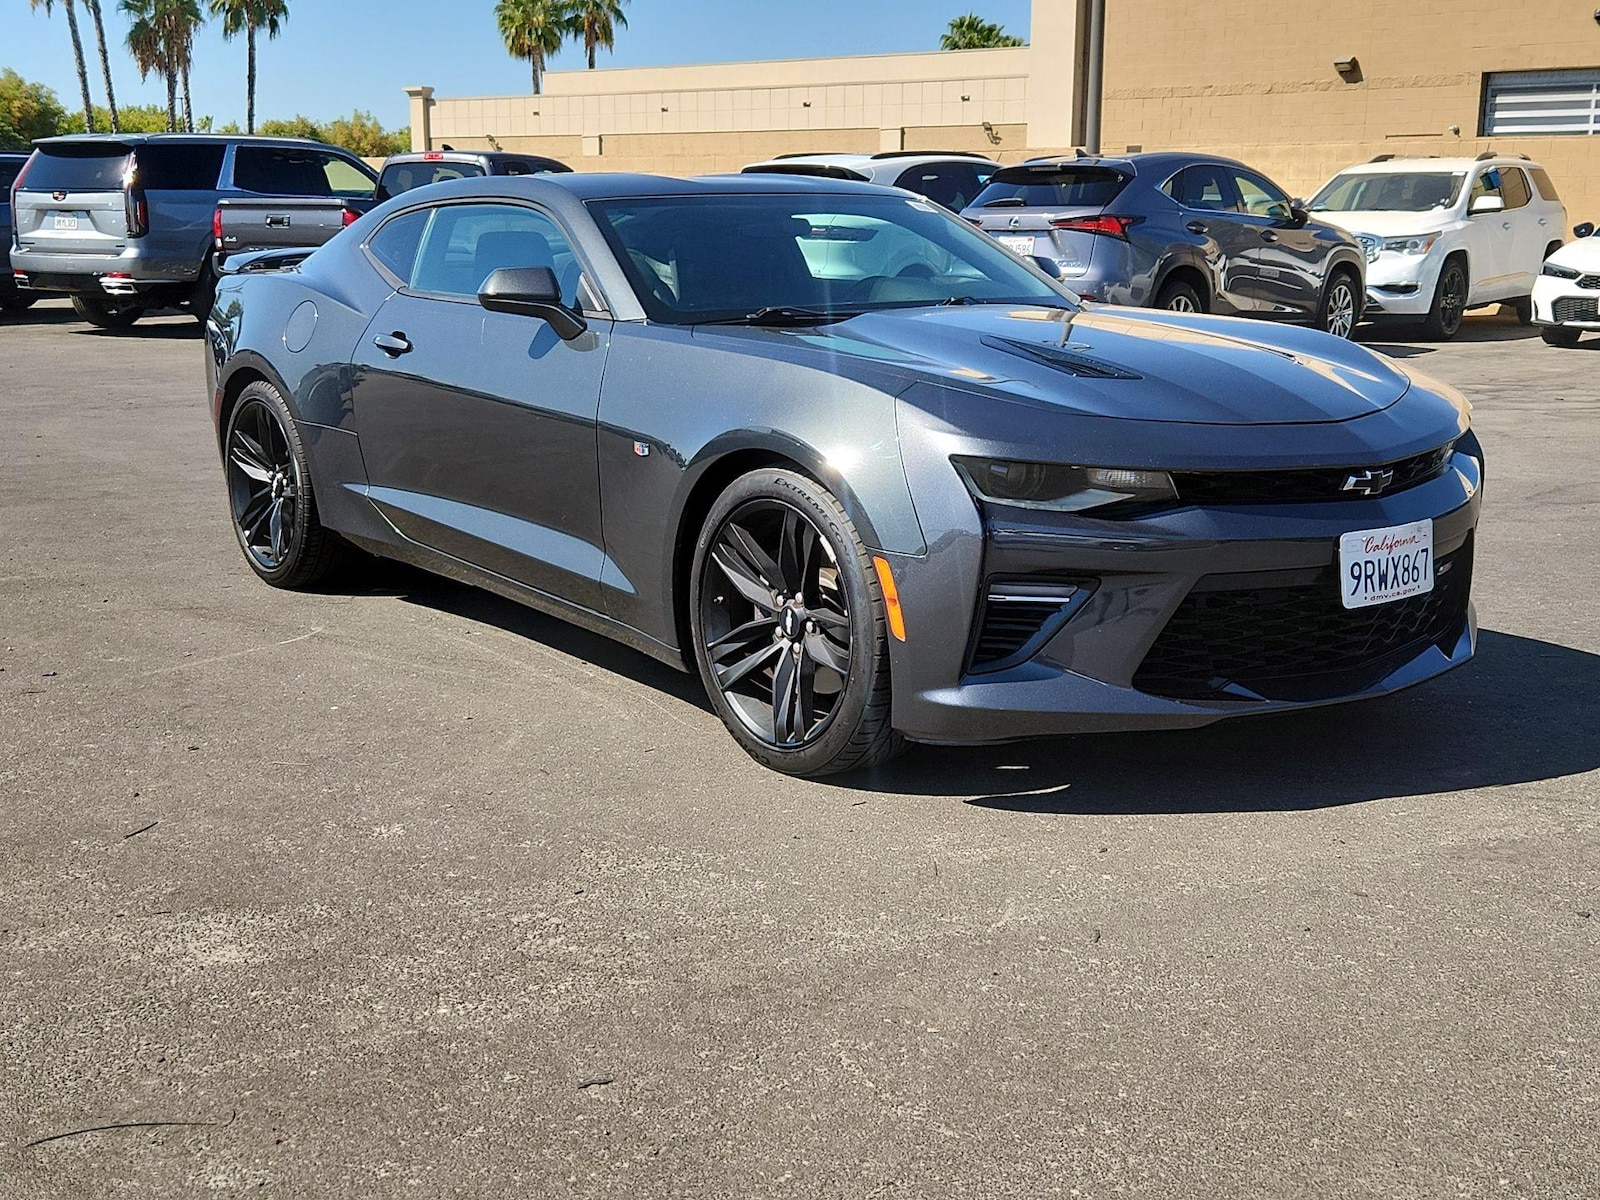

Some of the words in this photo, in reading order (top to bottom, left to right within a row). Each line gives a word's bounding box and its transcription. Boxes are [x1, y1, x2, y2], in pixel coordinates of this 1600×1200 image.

[1365, 533, 1420, 555] California
[1350, 547, 1429, 596] 9RWX867
[1370, 587, 1416, 601] dmv.ca.gov
